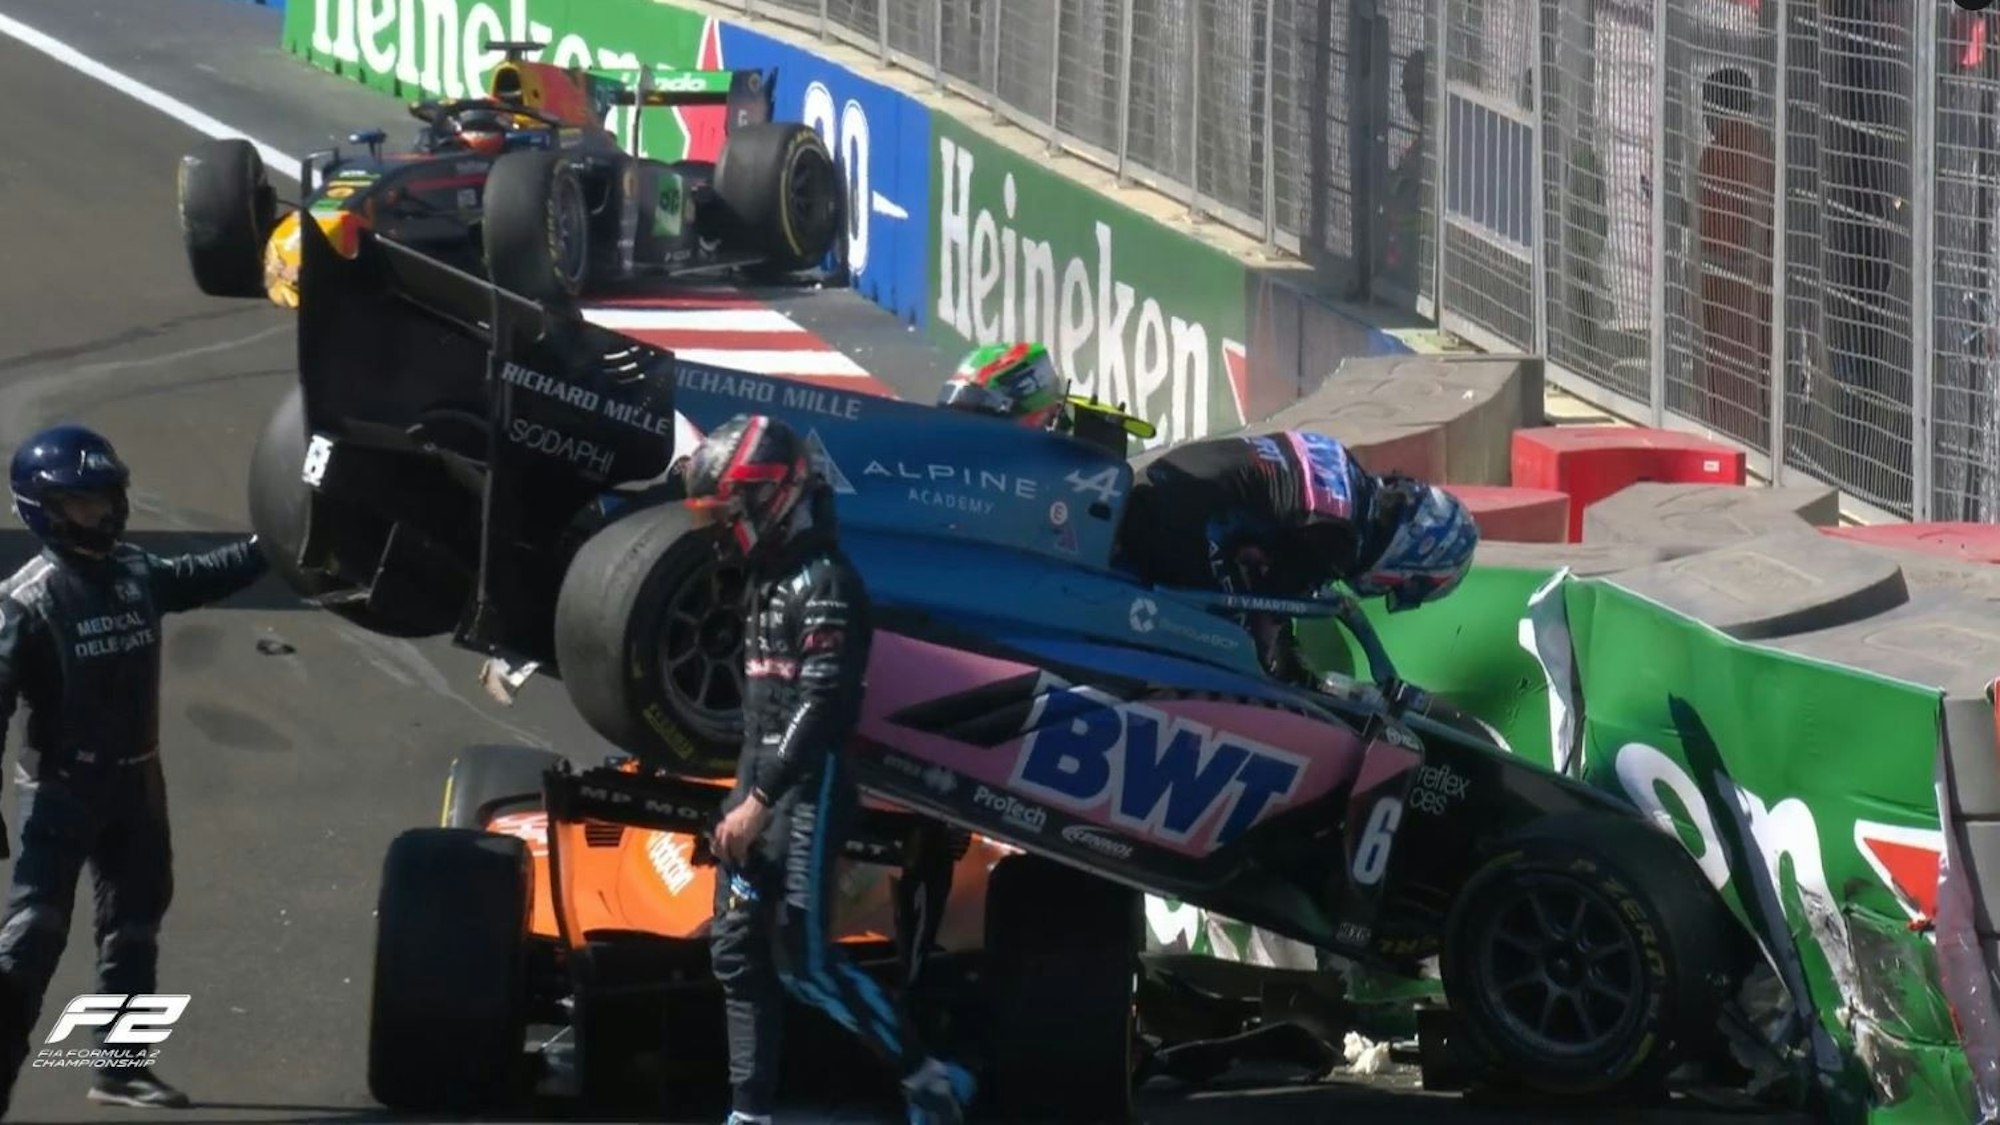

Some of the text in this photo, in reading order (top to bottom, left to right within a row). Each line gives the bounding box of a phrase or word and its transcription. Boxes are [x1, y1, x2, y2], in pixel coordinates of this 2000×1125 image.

[938, 137, 1209, 450] Heineken
[501, 362, 671, 436] RICHARD MILLE
[674, 366, 862, 420] ICHARD MILLE
[509, 418, 616, 474] SODAPHI
[863, 459, 1038, 499] ALPINE
[908, 488, 995, 515] ACADEMY
[75, 629, 156, 657] DELEGATE
[77, 611, 144, 636] MEDICAL
[1015, 683, 1306, 850] BWT
[1417, 763, 1471, 799] reflex
[973, 785, 1047, 827] ProTech
[1353, 796, 1404, 885] 6
